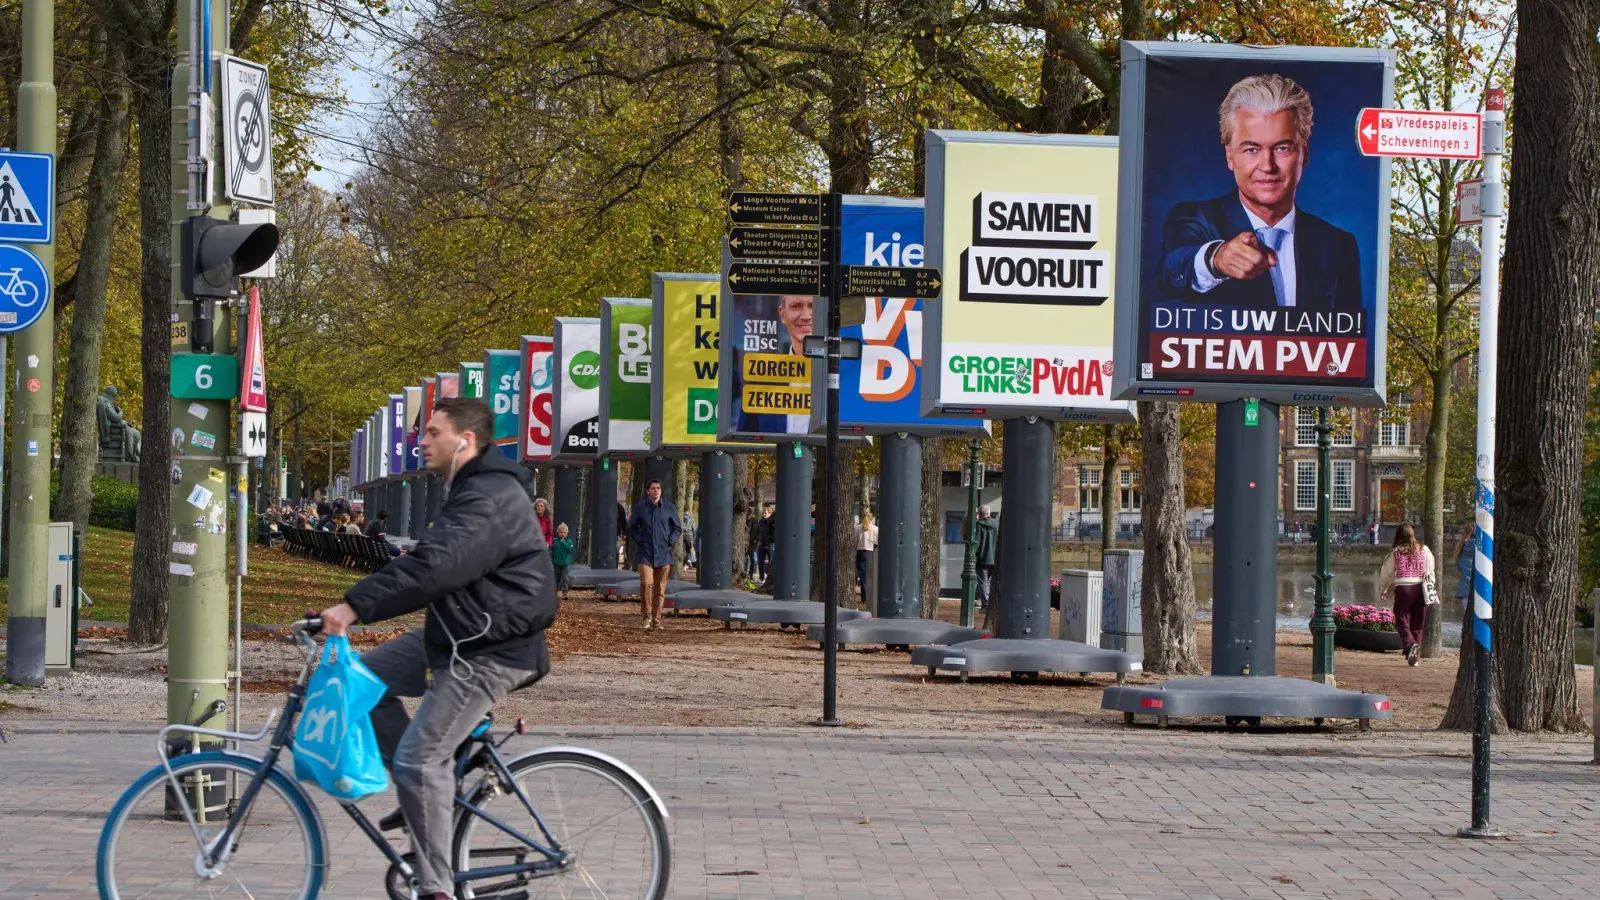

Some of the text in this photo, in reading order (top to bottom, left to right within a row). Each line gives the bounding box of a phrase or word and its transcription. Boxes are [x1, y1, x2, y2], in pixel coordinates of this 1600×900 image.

[239, 70, 257, 87] ZONE
[1396, 116, 1468, 131] Vredespaleis
[1381, 134, 1469, 151] Scheveningen 3
[743, 196, 763, 205] Lange
[765, 196, 798, 204] Voorhout
[988, 201, 1091, 233] SAMEN
[769, 232, 800, 241] Diligentia
[773, 241, 798, 250] Pepijn
[742, 266, 776, 274] Nationaal
[777, 267, 800, 275] Toneel
[742, 275, 769, 283] Centraal
[852, 269, 890, 277] Binnenhof
[975, 256, 1103, 289] VOORUIT
[852, 278, 897, 286] Mauritshuis
[743, 319, 777, 334] STEM
[1155, 308, 1362, 334] DIT IS UW LAND!
[1161, 337, 1265, 371] STEM
[1276, 341, 1356, 373] PVV
[623, 362, 652, 377] LE
[748, 360, 806, 377] ZORGEN
[948, 356, 1032, 376] GROEN
[195, 364, 213, 389] 6
[962, 375, 1031, 394] LINKS
[1032, 358, 1104, 396] PvdA
[747, 391, 811, 409] ZEKERHE
[693, 400, 718, 422] D
[568, 435, 598, 447] Bon
